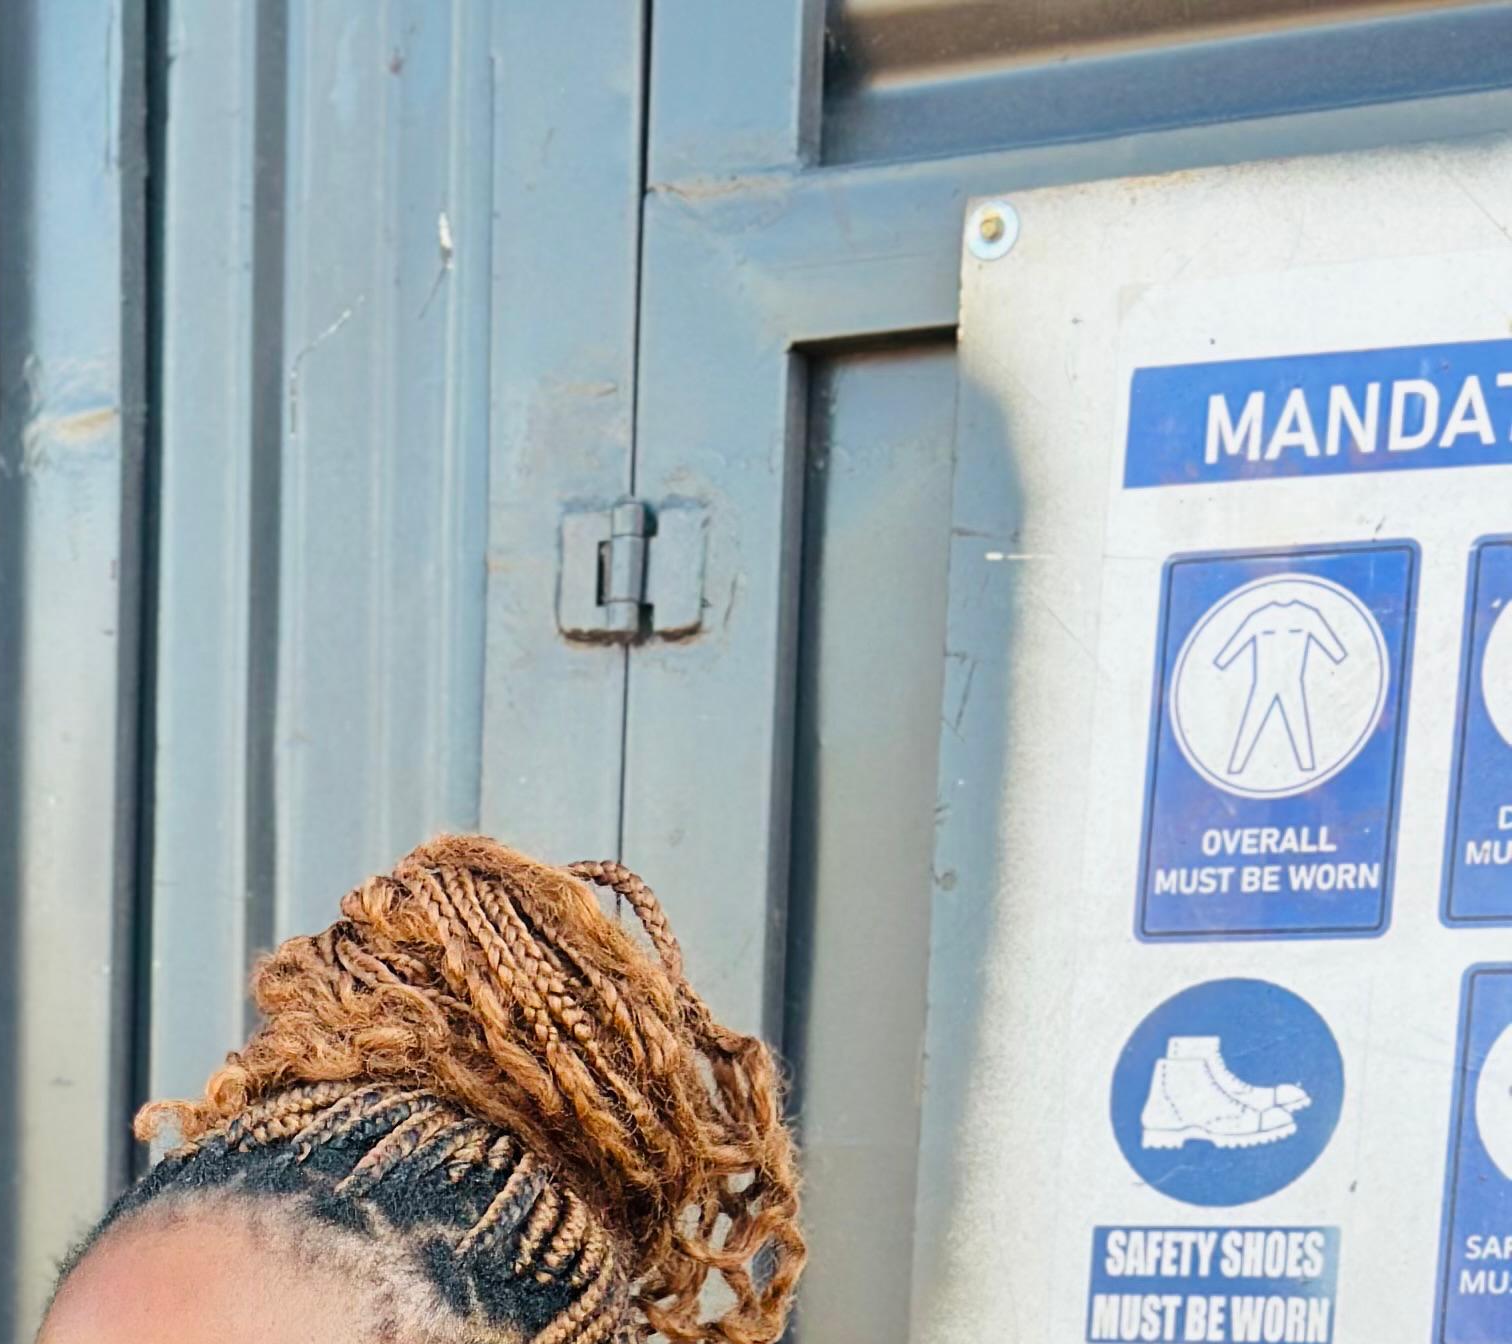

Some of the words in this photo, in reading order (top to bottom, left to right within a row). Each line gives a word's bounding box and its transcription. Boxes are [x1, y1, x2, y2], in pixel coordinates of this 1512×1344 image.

[1201, 826, 1337, 857] OVERALL
[1465, 840, 1512, 865] MU
[1154, 867, 1236, 895] MUST
[1240, 865, 1282, 893] BE
[1288, 863, 1381, 891] WORN
[1105, 1229, 1219, 1277] SAFETY
[1219, 1230, 1326, 1279] SHOES
[1091, 1293, 1182, 1342] MUST
[1184, 1294, 1227, 1343] BE
[1230, 1295, 1331, 1344] WORN
